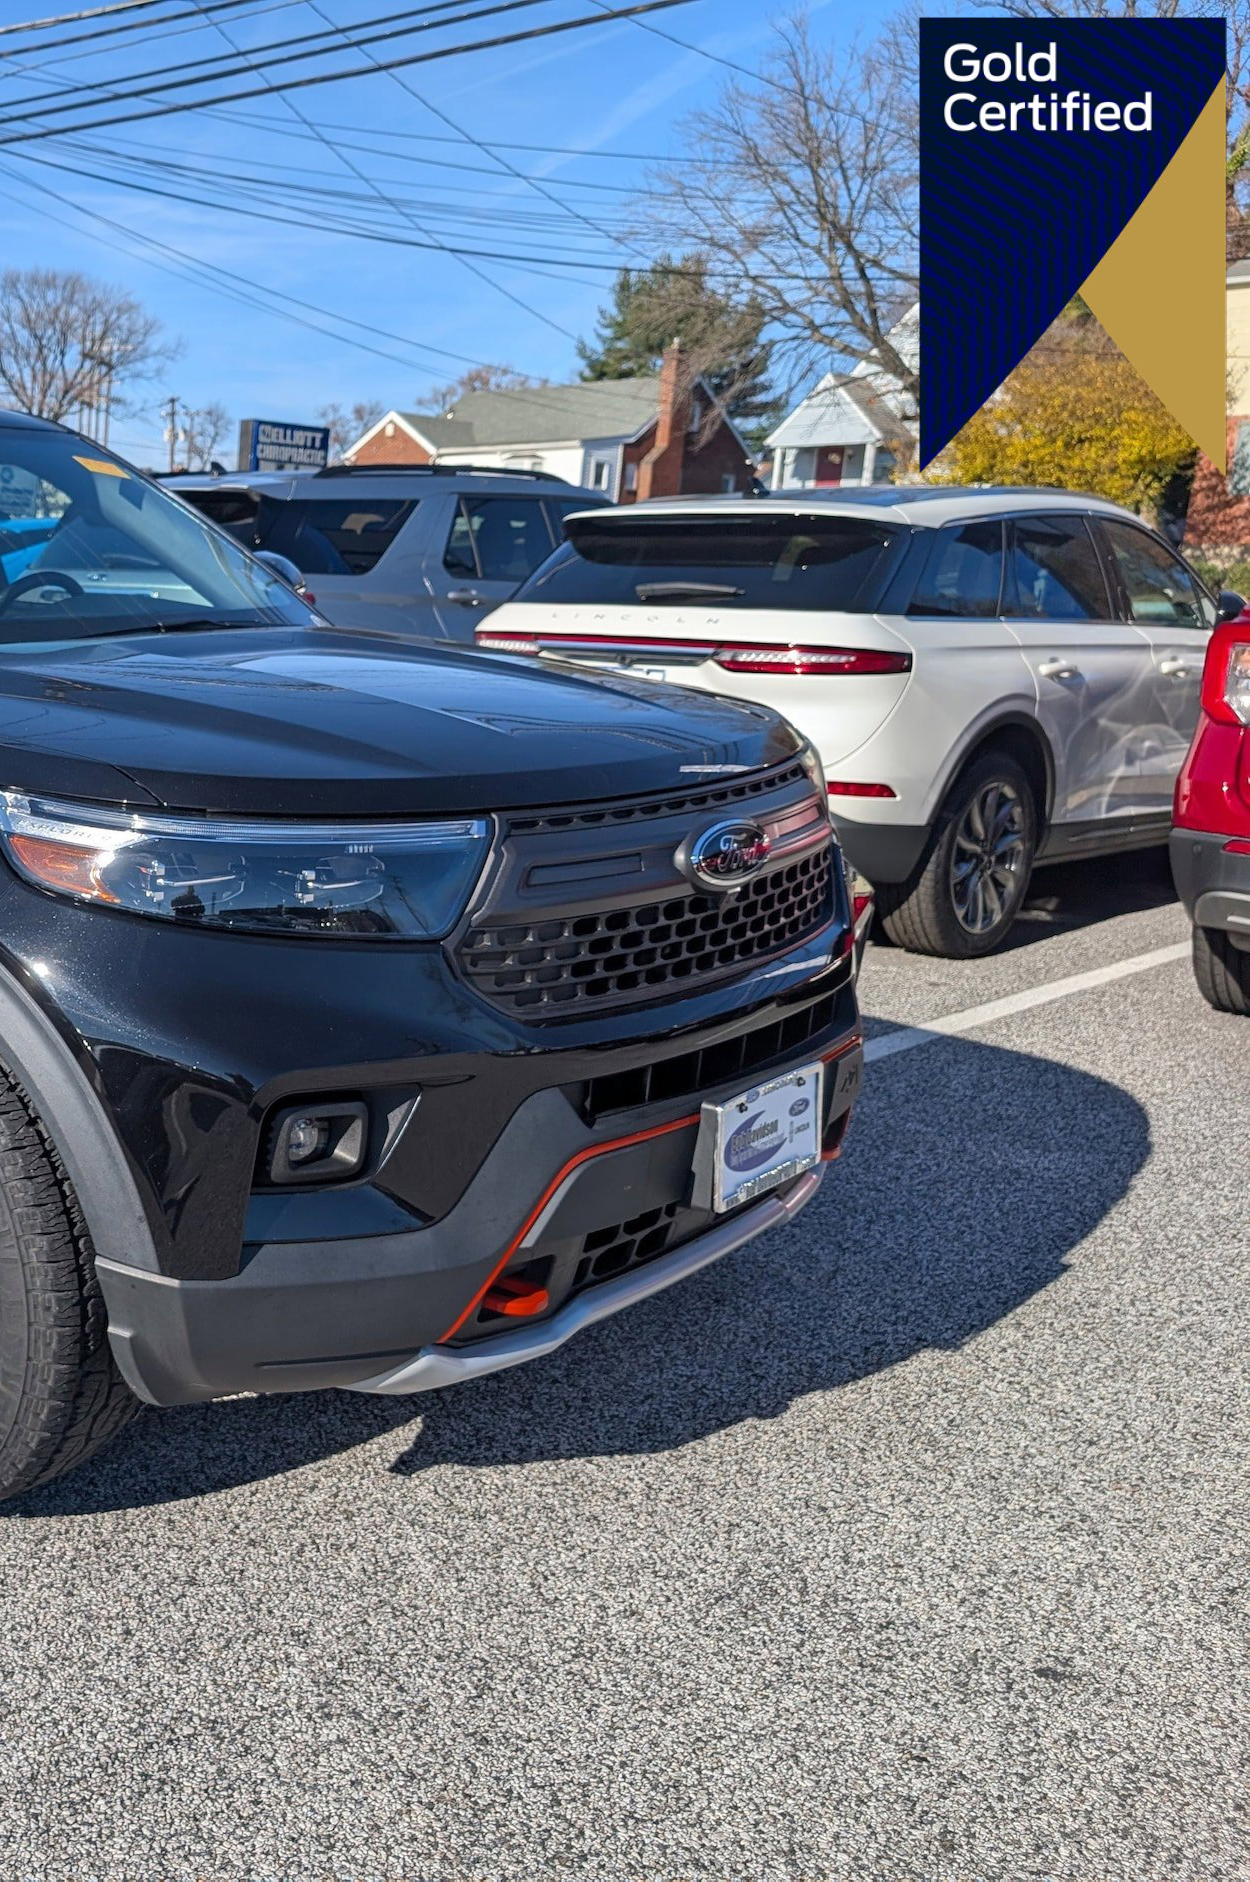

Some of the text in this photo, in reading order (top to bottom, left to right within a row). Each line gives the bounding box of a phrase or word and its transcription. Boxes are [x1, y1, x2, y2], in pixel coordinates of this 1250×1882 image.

[270, 427, 324, 449] ELLIOTT
[257, 443, 326, 466] CHIROPRACTIC
[551, 611, 720, 626] LINCOLN
[16, 818, 112, 842] EXPLOR
